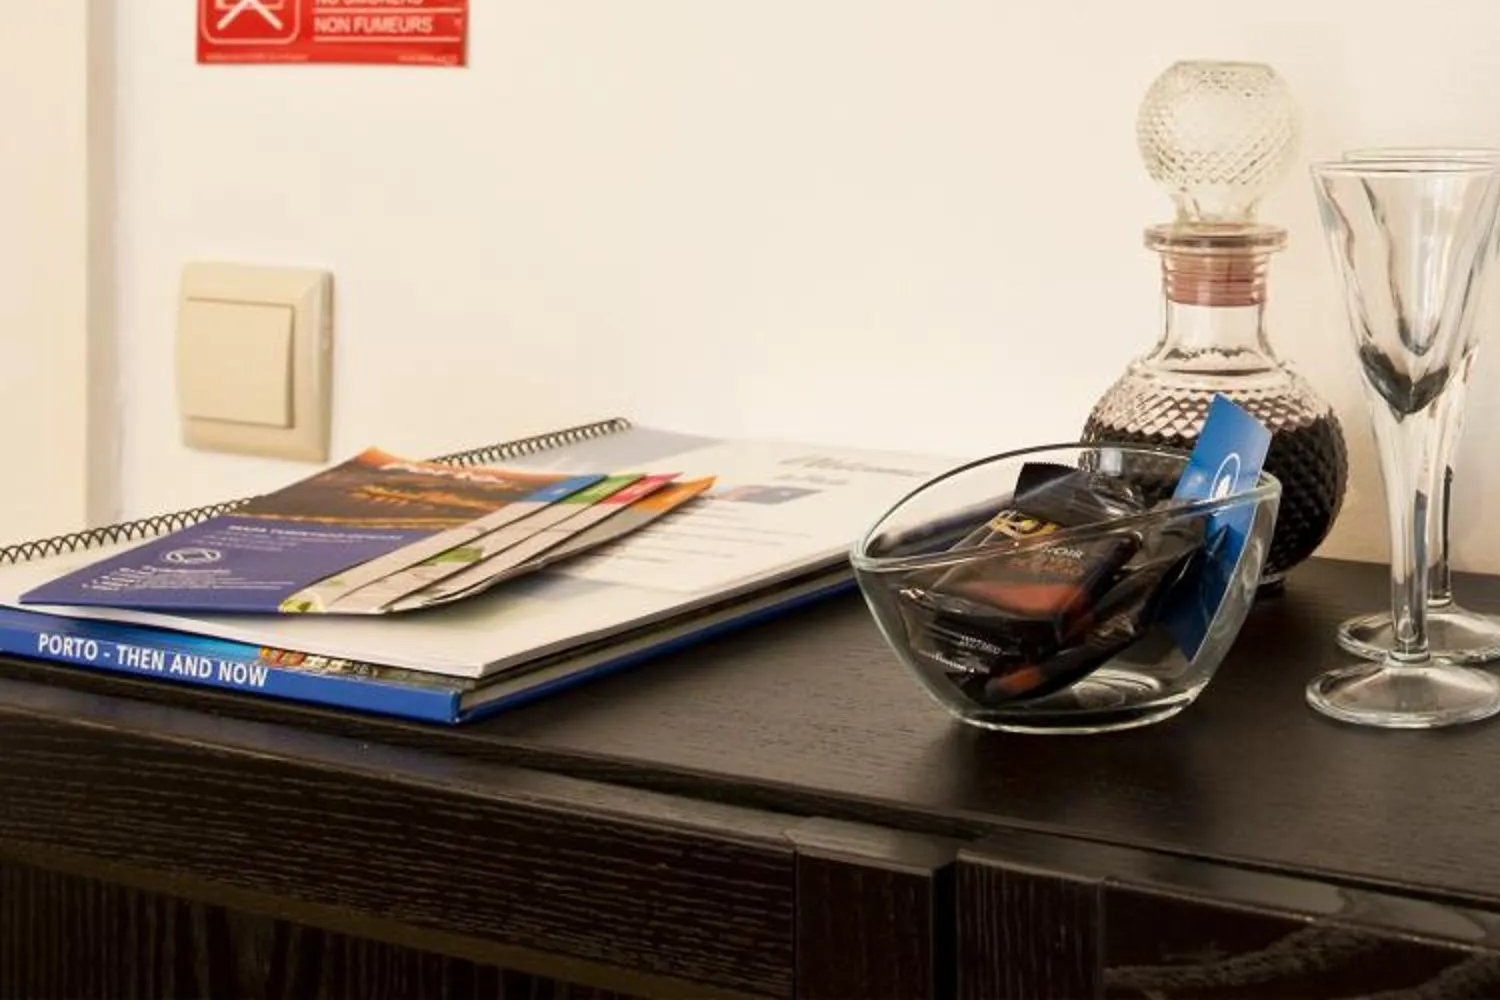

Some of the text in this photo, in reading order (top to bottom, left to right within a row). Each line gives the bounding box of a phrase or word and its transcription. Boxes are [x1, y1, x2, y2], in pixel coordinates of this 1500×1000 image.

[314, 15, 433, 34] NON FUMEURS
[37, 632, 99, 662] PORTO
[115, 644, 166, 672] THEN
[169, 653, 212, 679] AND
[218, 663, 269, 688] NOW
